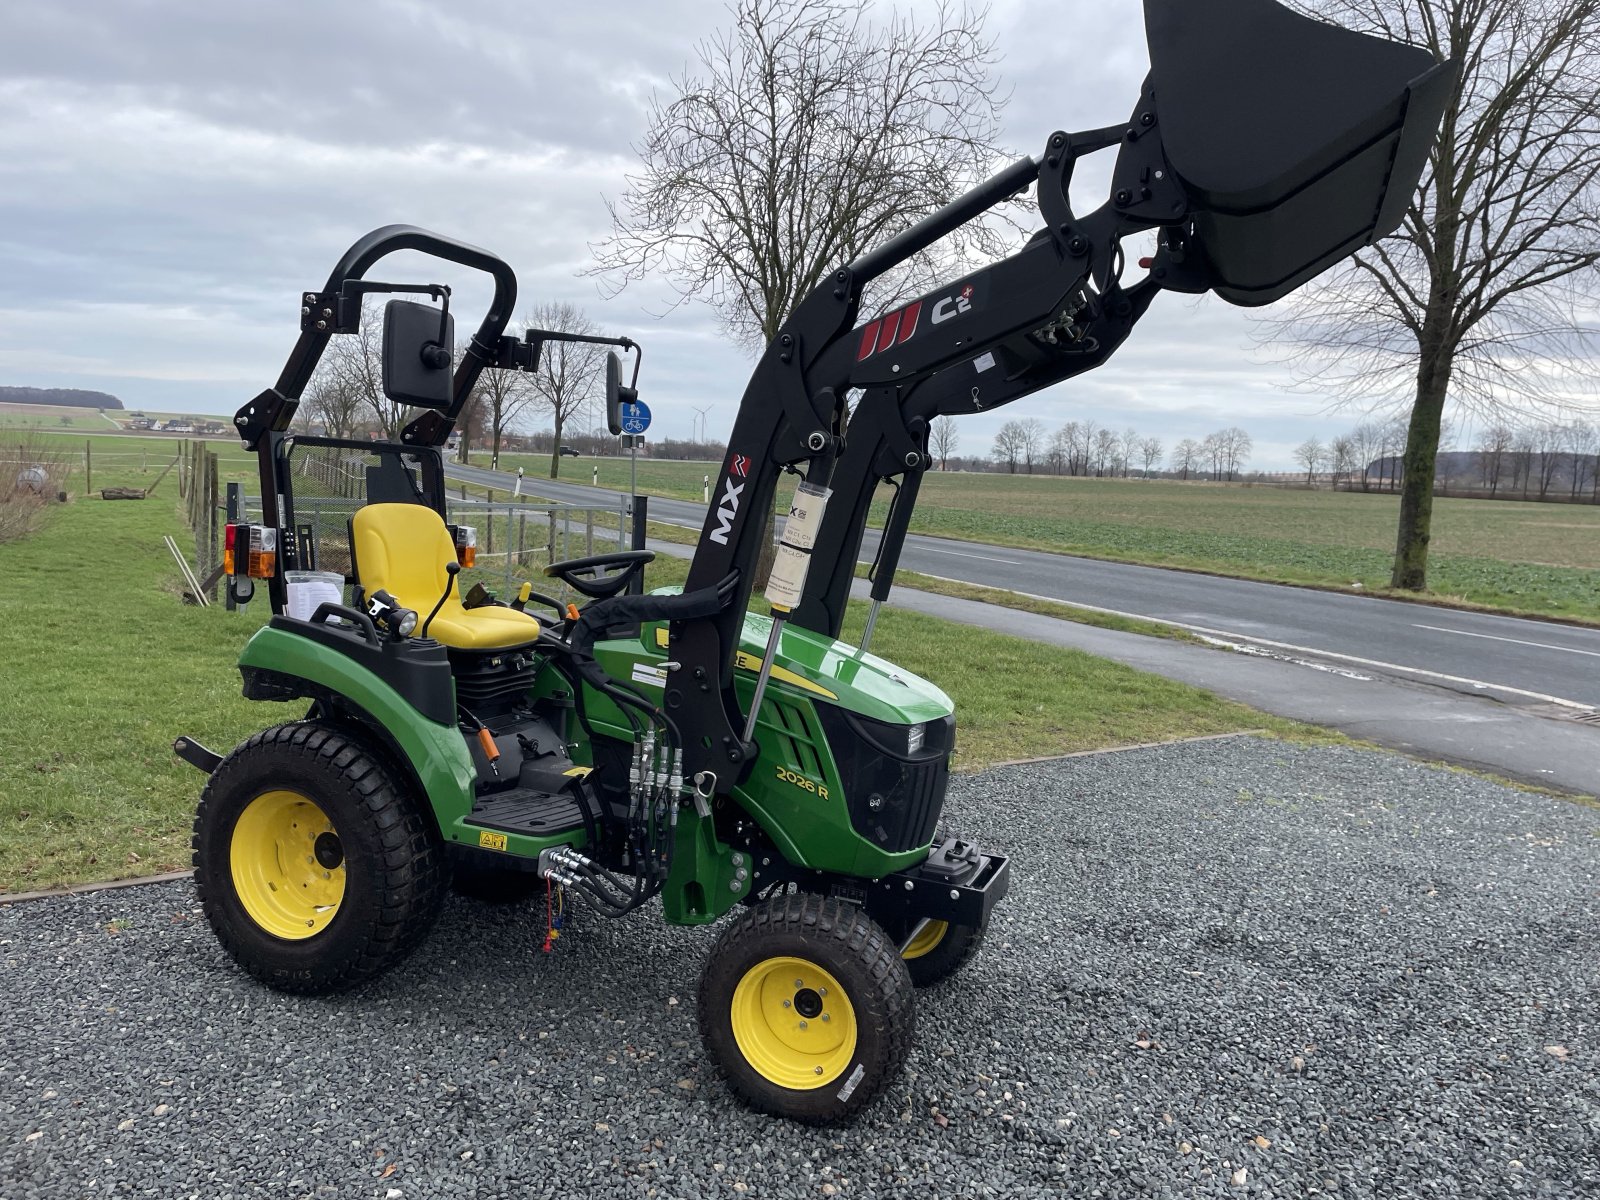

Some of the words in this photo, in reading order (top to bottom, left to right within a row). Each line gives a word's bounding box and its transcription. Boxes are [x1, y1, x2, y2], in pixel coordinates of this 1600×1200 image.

[709, 475, 745, 546] MX
[776, 765, 815, 793] 2026
[818, 785, 829, 801] R
